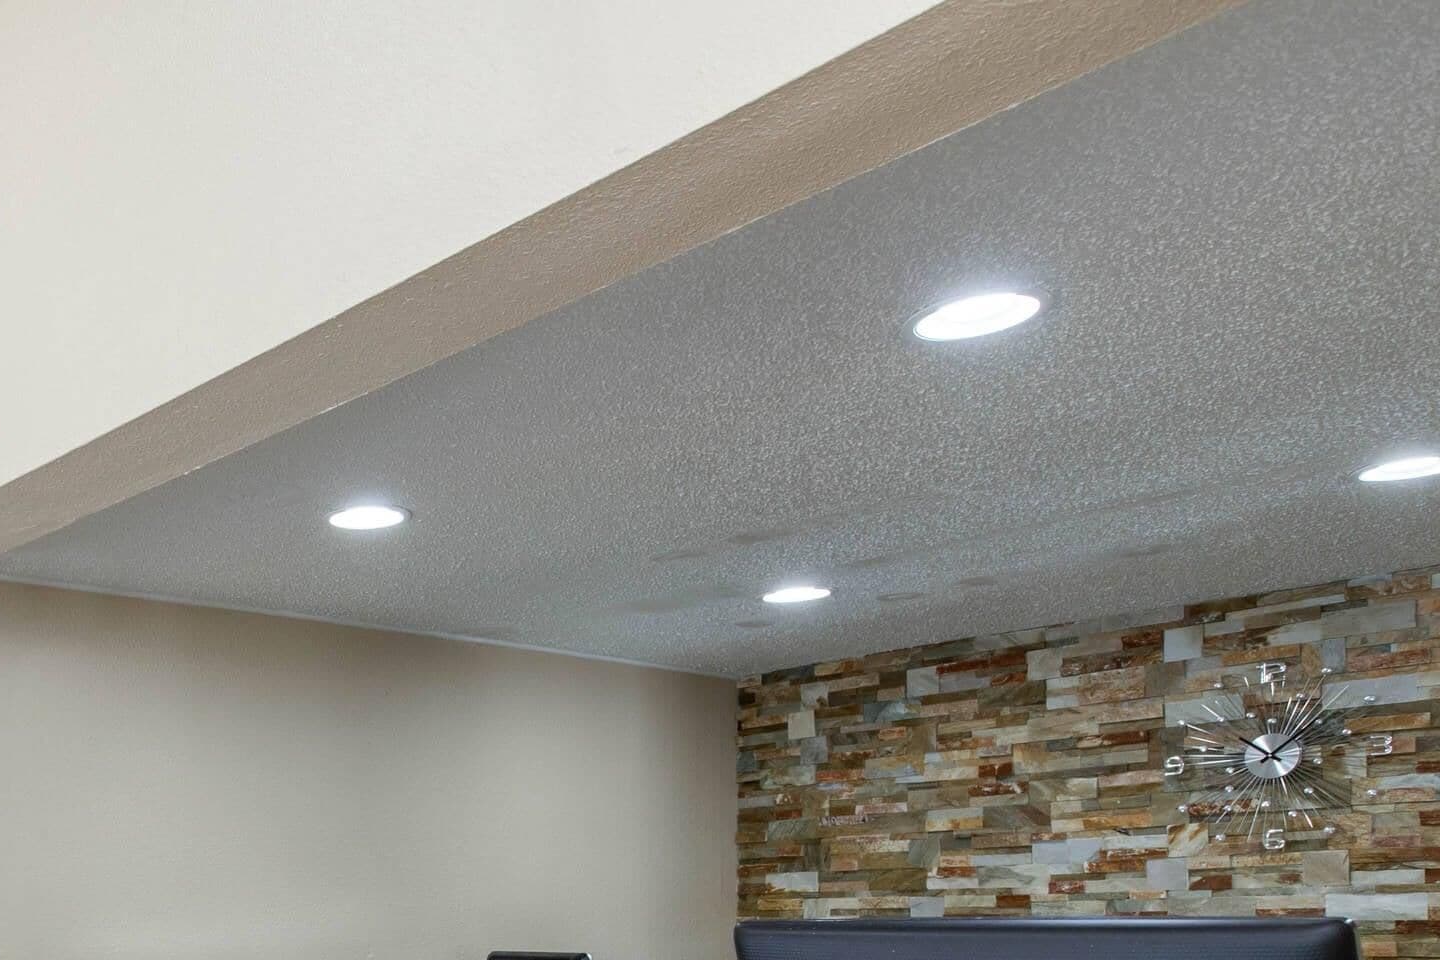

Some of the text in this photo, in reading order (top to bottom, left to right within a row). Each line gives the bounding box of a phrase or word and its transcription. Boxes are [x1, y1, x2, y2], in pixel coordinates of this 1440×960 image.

[1370, 735, 1392, 755] 3
[1164, 755, 1185, 777] 9
[1263, 828, 1286, 850] 6
